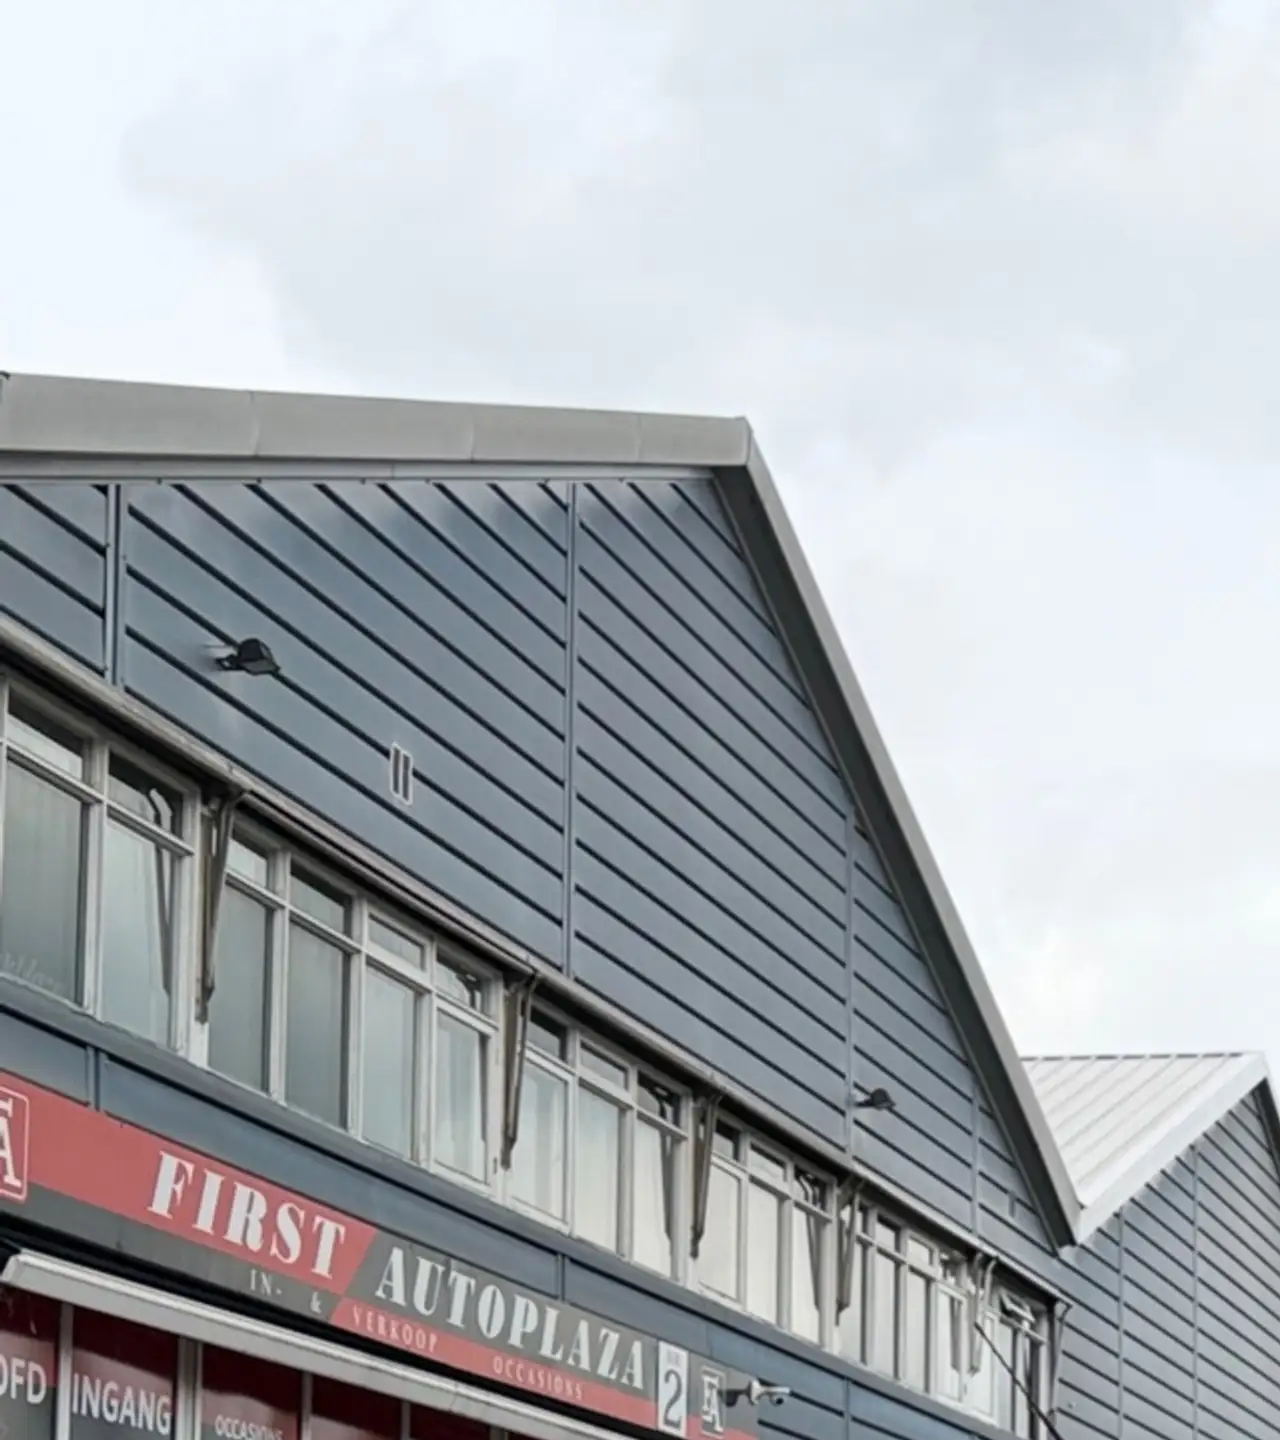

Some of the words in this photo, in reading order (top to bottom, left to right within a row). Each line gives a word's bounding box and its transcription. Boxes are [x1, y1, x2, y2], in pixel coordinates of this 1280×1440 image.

[0, 1097, 22, 1188] A
[147, 1150, 346, 1280] FIRST
[374, 1246, 644, 1390] AUTOPLAZA
[351, 1305, 438, 1353] VERKOOP
[492, 1355, 583, 1400] OCCASIONS
[72, 1372, 173, 1436] INGANG
[663, 1369, 683, 1431] 2
